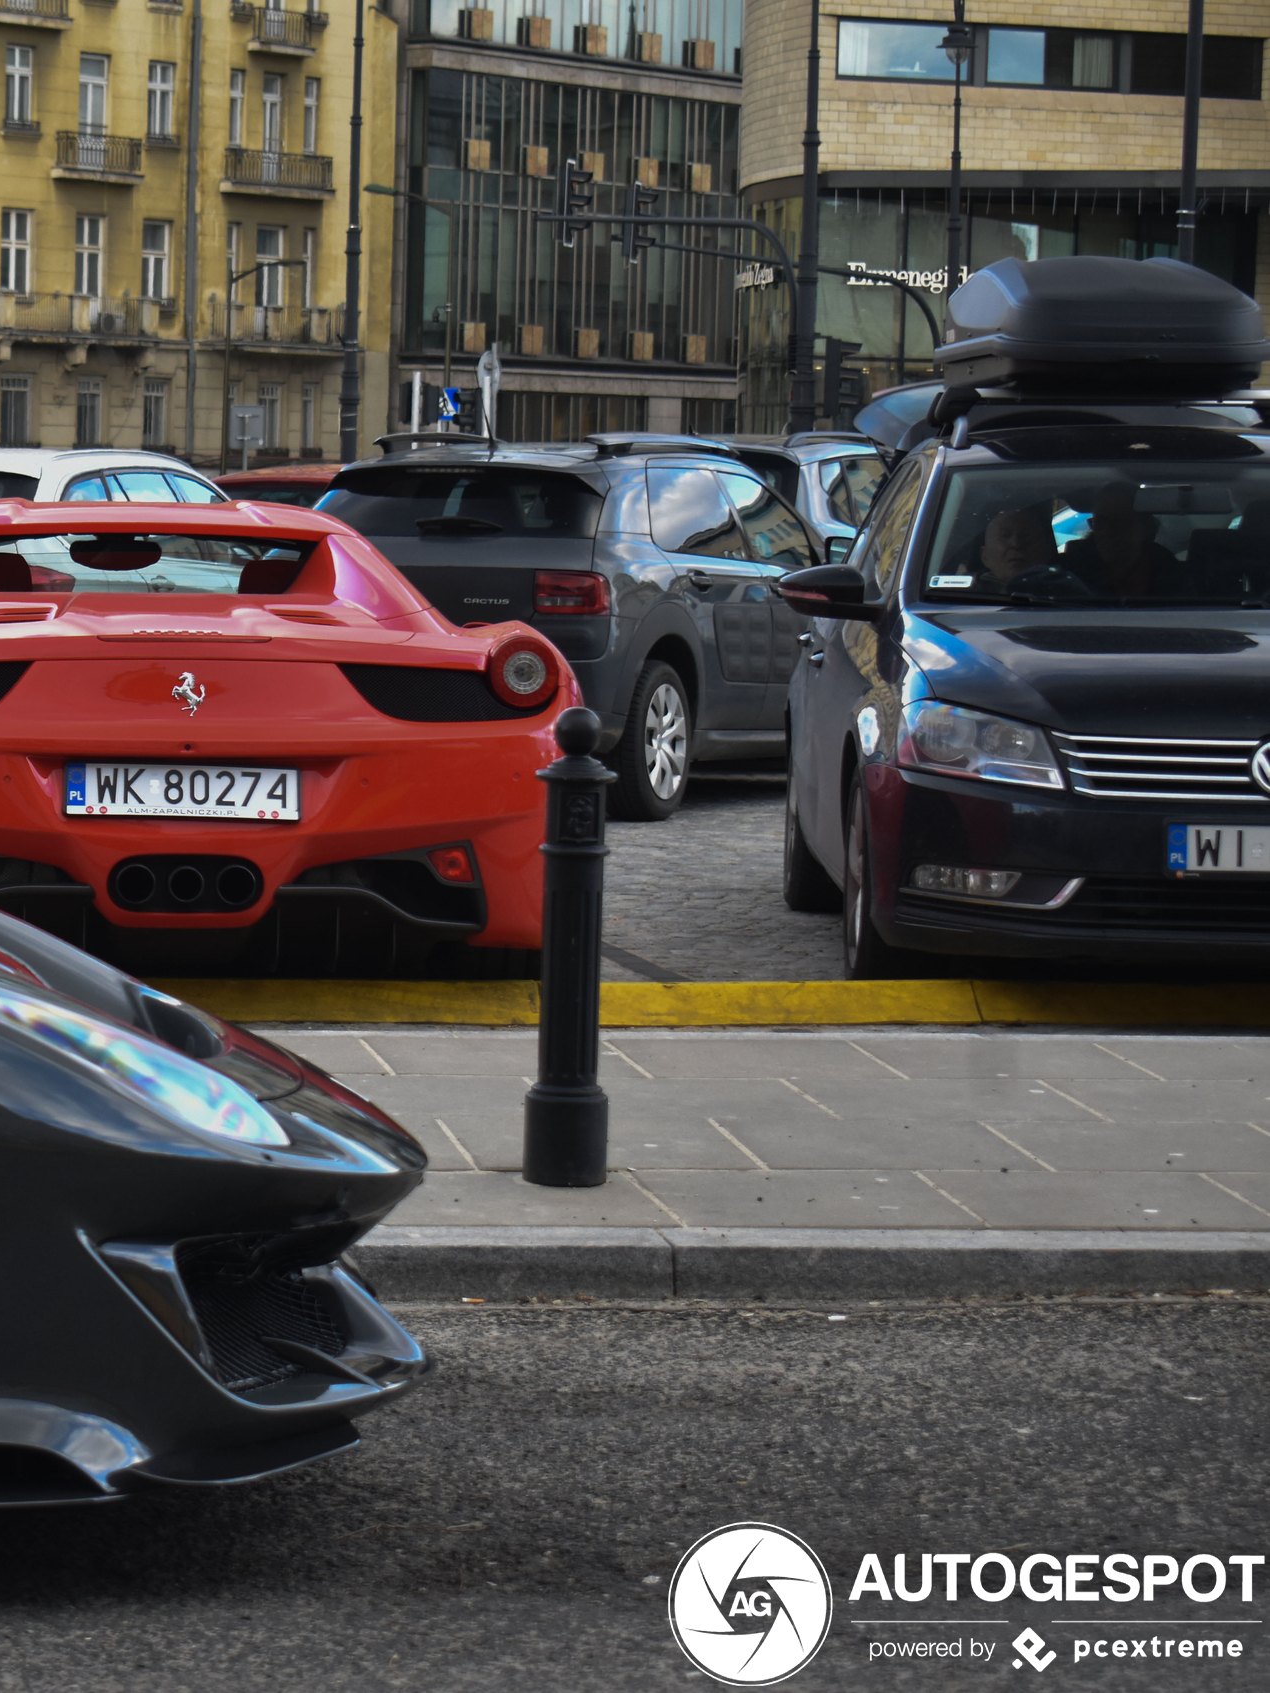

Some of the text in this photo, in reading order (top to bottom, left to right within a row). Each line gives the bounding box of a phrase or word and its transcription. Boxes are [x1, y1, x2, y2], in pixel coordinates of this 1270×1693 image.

[463, 597, 510, 605] CACTUS
[96, 767, 288, 809] WK 80274
[69, 790, 83, 801] PL
[126, 807, 240, 817] ALM-ZAPALNICZKI.PL
[1170, 852, 1185, 864] PL
